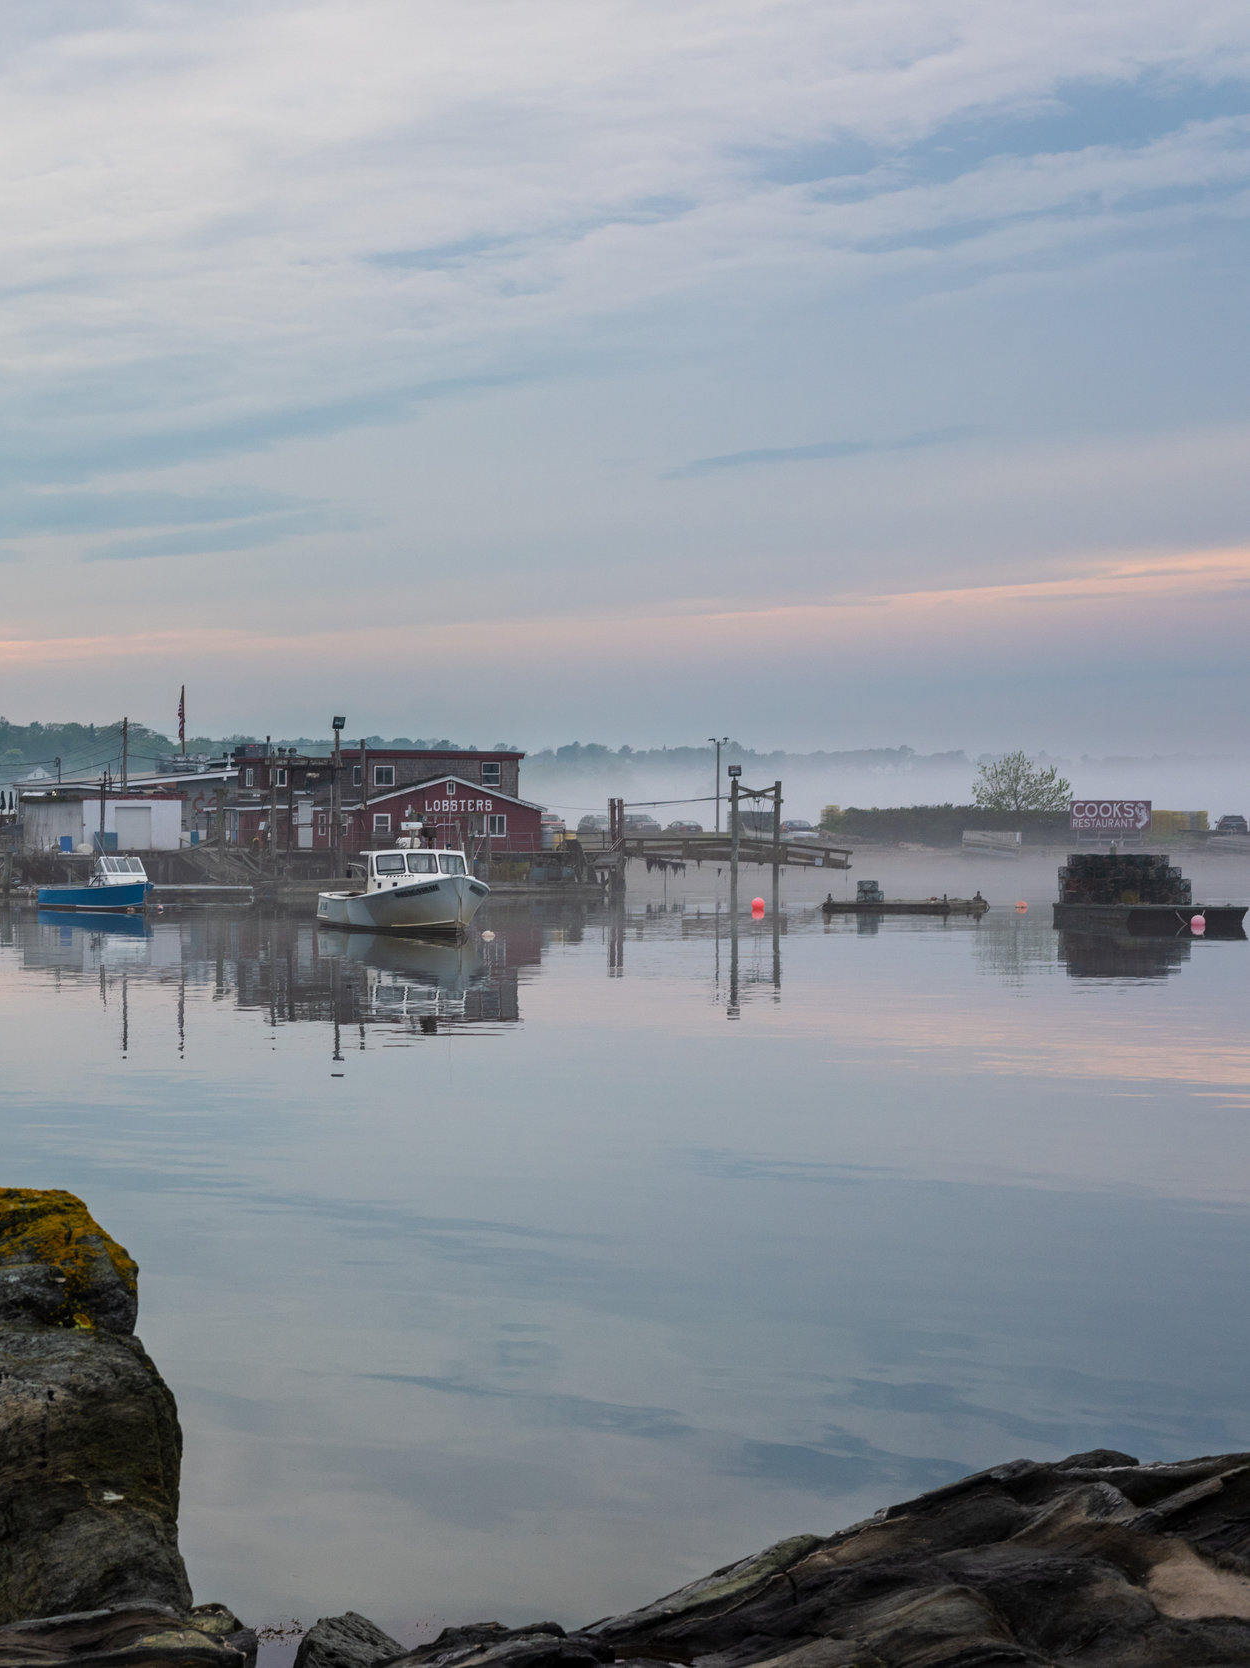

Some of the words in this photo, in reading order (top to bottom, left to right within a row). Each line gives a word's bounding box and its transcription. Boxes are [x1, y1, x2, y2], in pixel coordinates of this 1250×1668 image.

[425, 800, 492, 811] LOBSTERS
[1073, 802, 1134, 817] COOK'S
[1072, 818, 1134, 828] RESTAURANT
